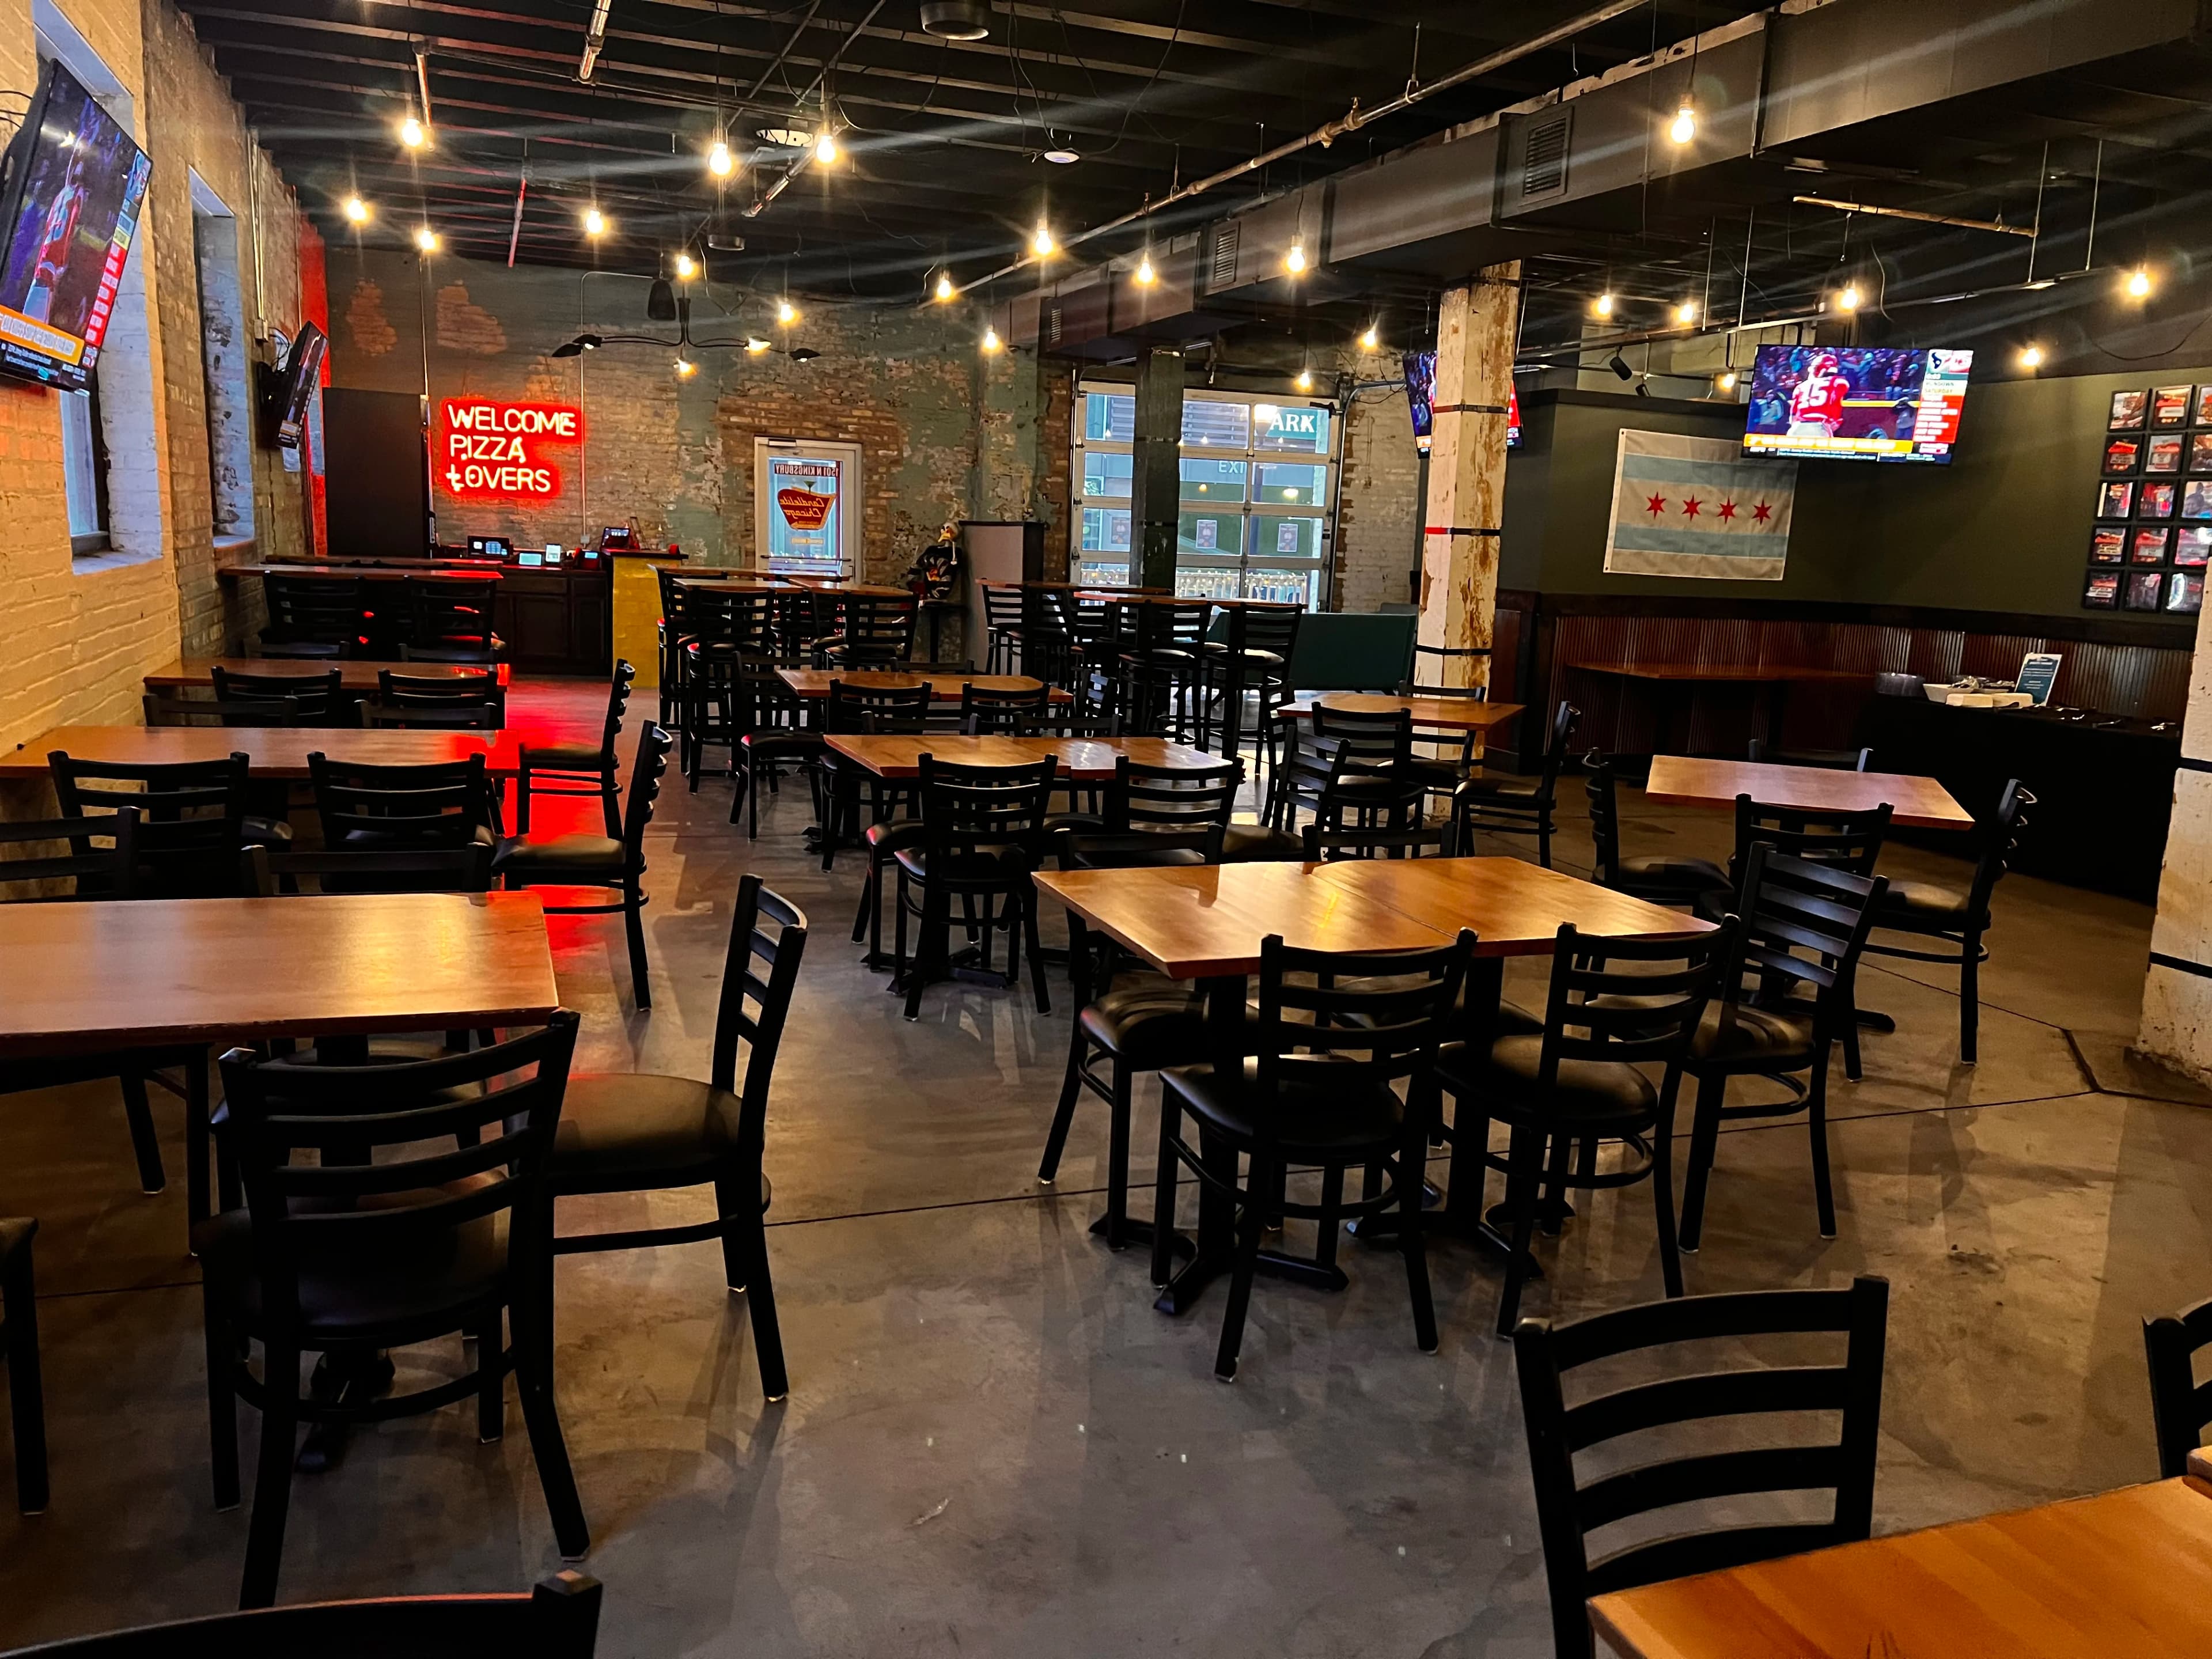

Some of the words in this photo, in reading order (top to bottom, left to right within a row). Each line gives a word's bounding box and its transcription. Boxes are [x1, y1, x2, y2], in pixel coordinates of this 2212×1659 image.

[448, 404, 575, 436] WELCOME
[1269, 412, 1315, 433] ARK
[449, 434, 526, 463] PIZZA
[446, 464, 551, 493] LOVERS
[1218, 461, 1244, 474] EXI
